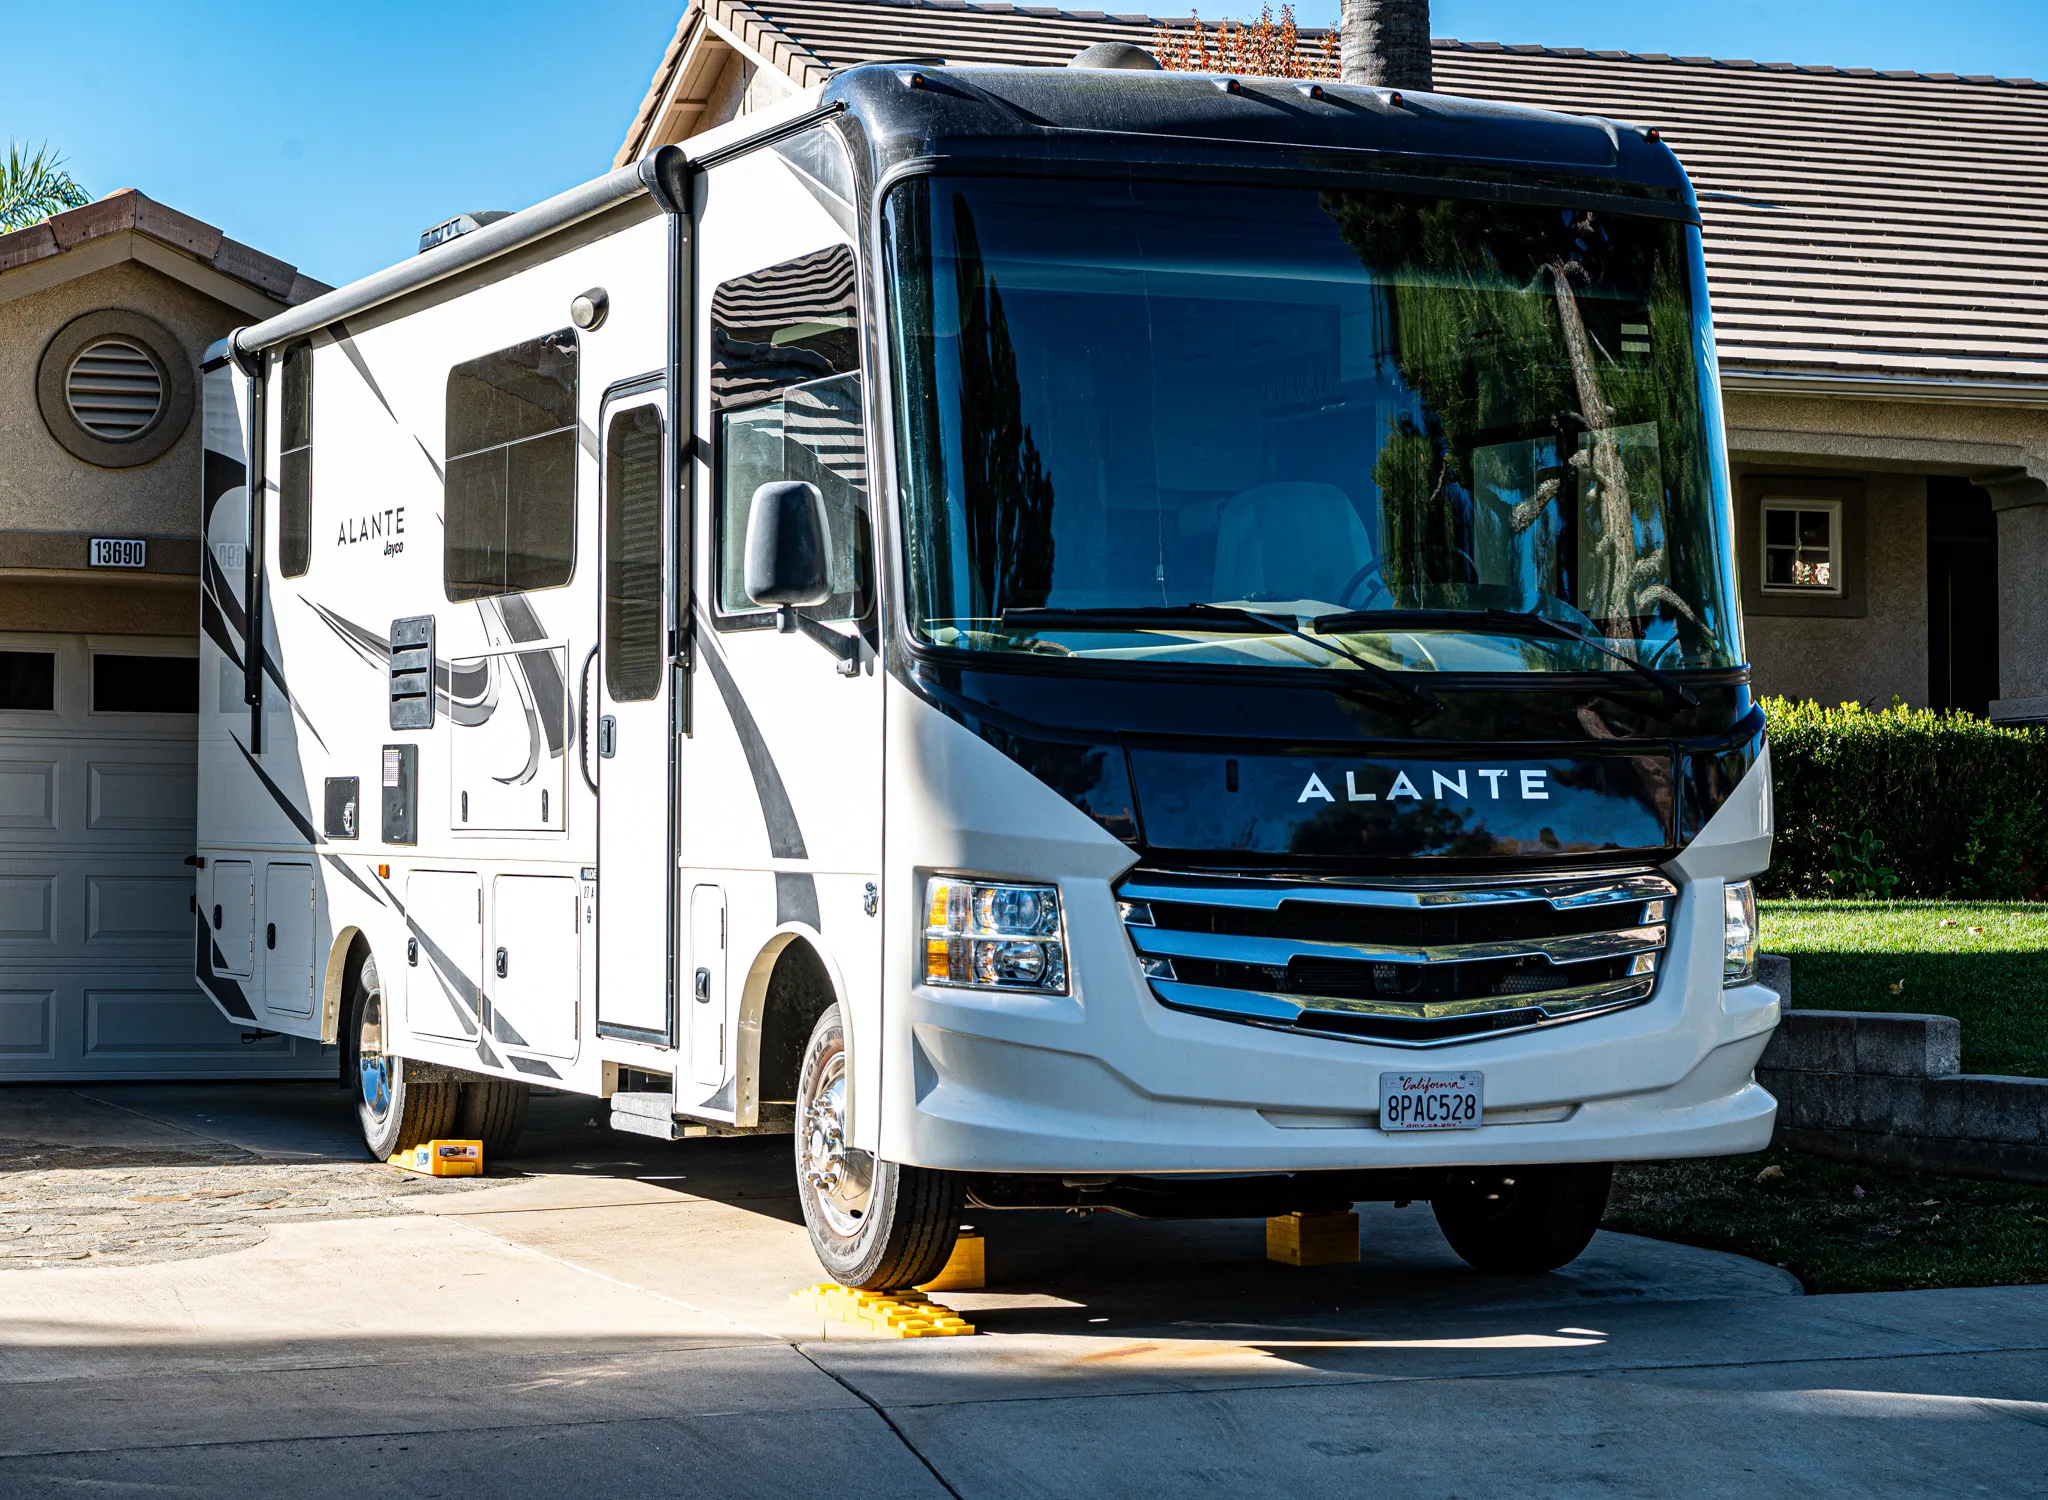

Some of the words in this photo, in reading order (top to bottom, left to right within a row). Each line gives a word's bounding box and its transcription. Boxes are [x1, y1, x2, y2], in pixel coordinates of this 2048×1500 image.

[337, 506, 405, 547] ALANTE
[94, 541, 143, 565] 13690
[383, 540, 404, 558] Jayco
[1297, 769, 1549, 803] ALANTE
[1402, 1076, 1465, 1094] California
[1388, 1094, 1476, 1122] 8PAC528
